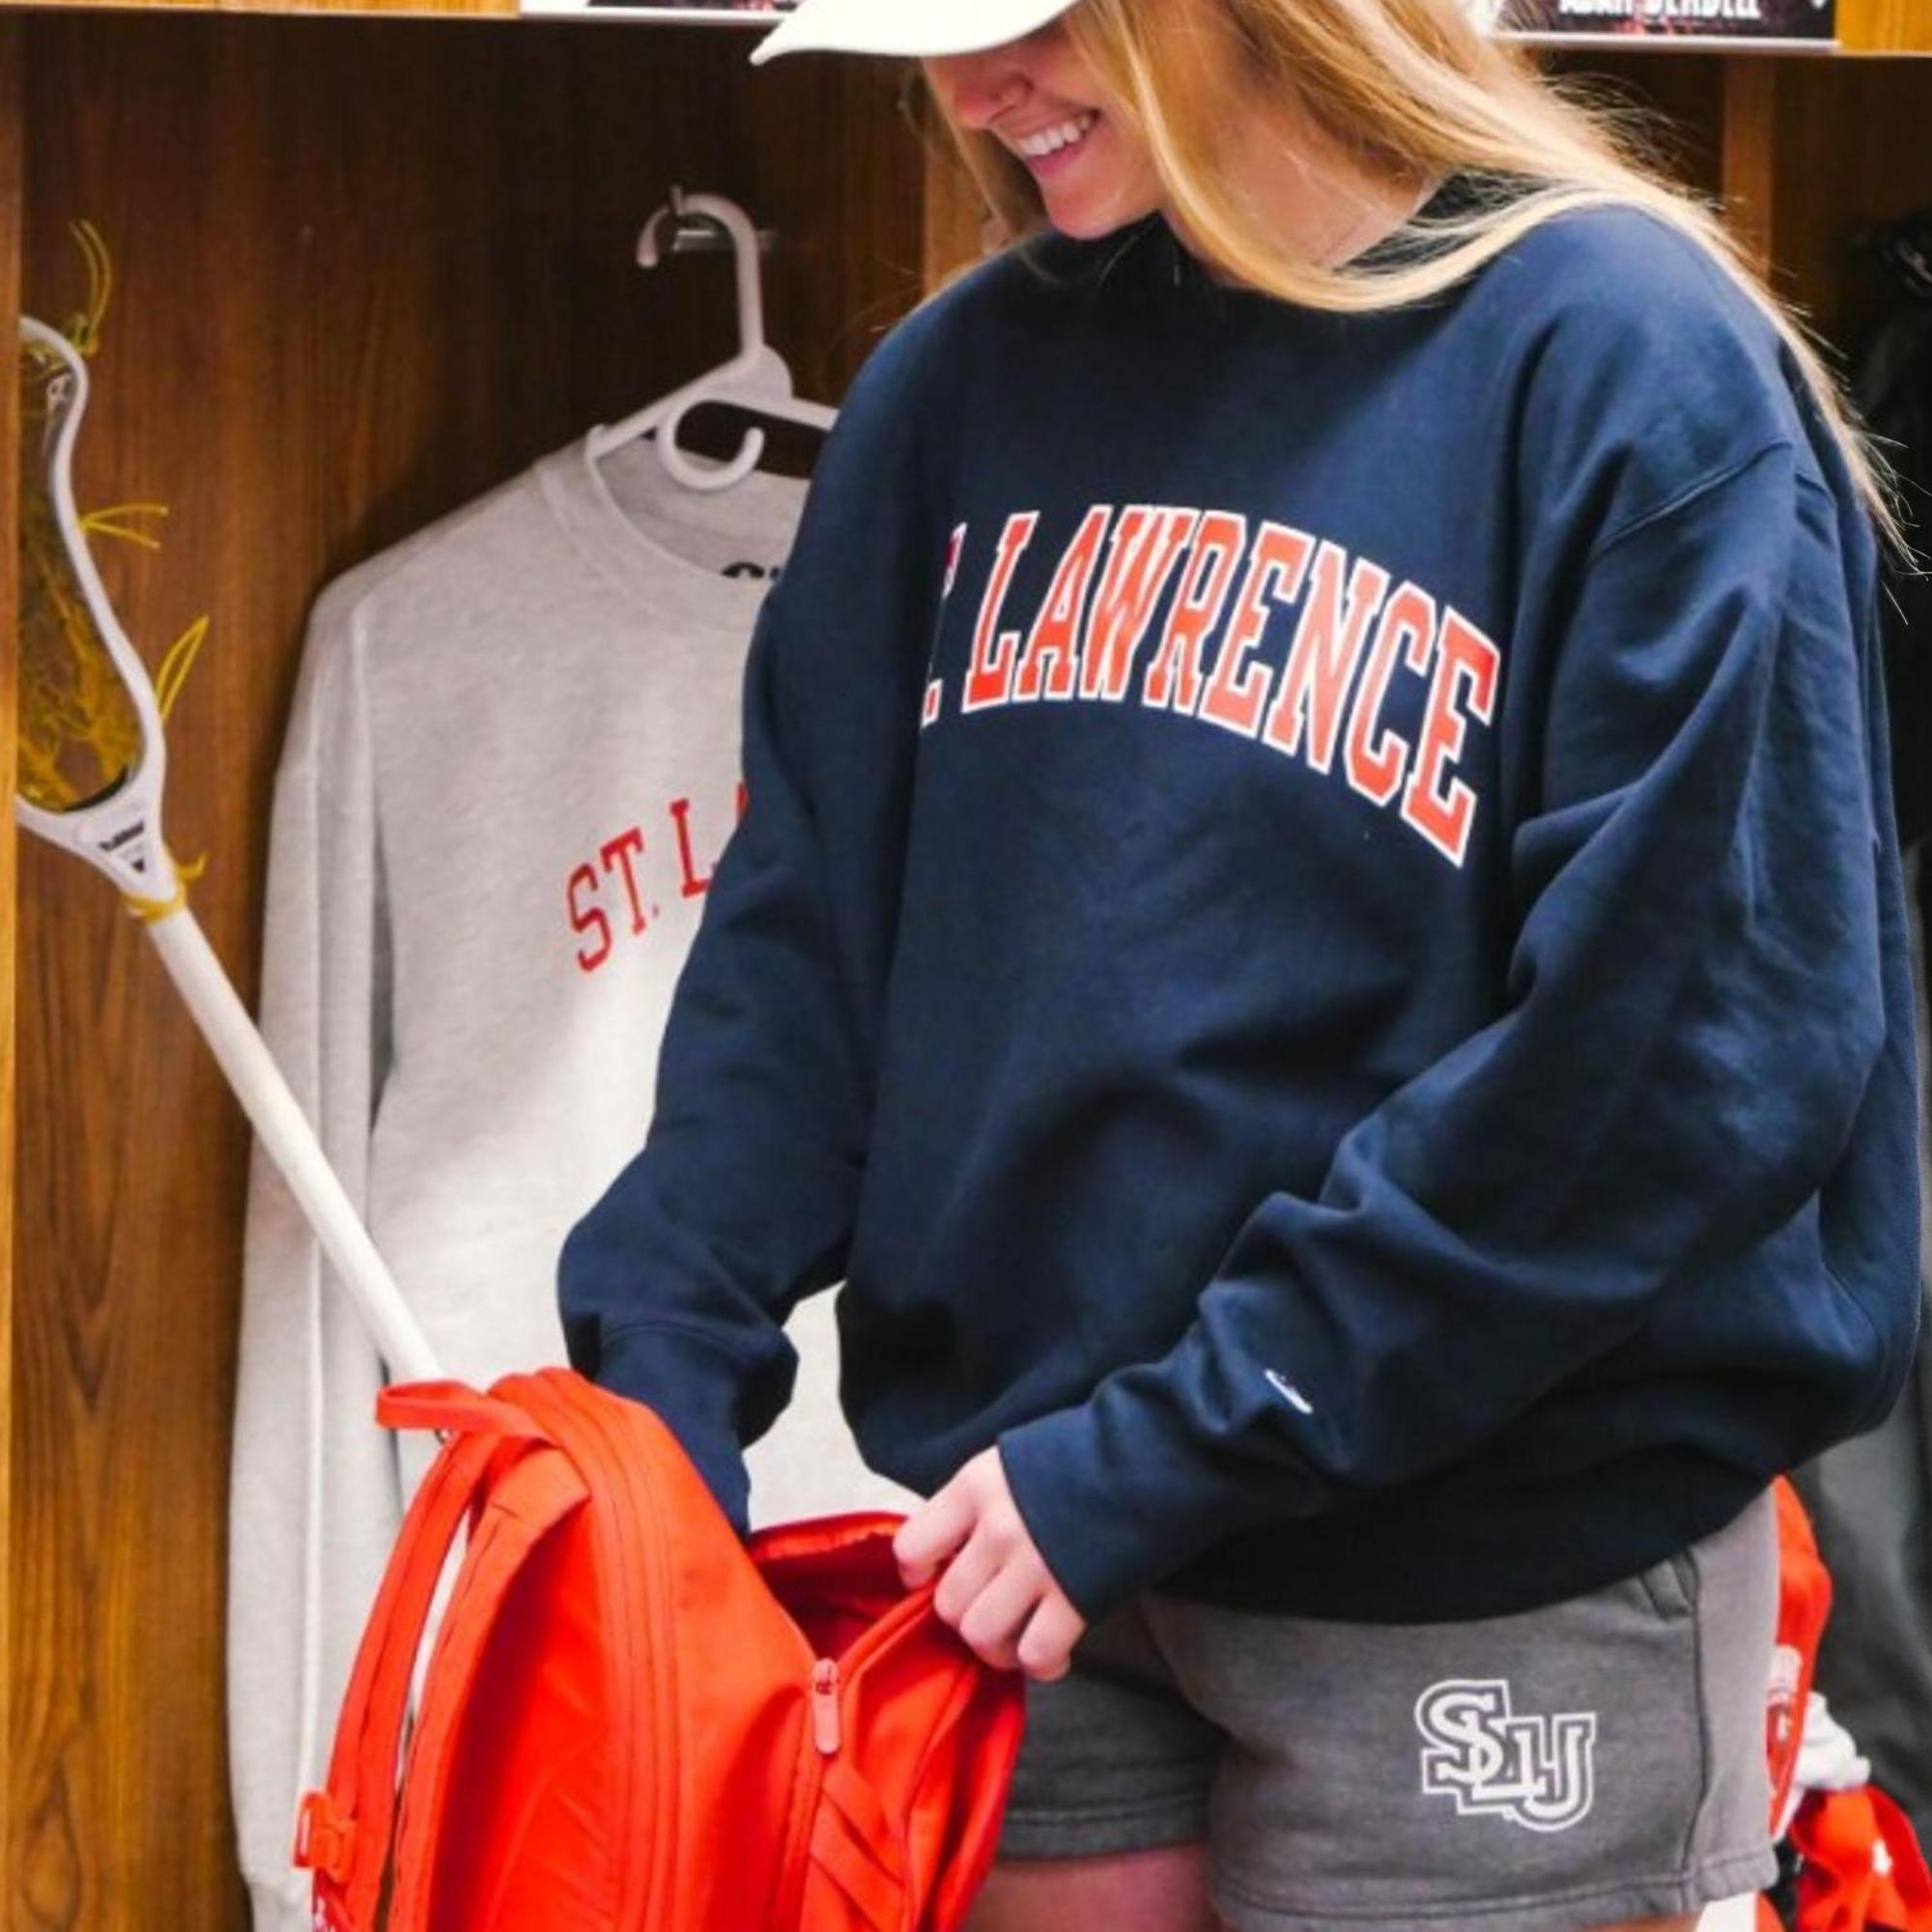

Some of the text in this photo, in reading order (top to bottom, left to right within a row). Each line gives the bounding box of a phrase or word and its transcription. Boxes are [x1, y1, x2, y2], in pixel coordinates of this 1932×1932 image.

[962, 503, 1501, 868] LAWRENCE
[566, 781, 749, 972] ST. L
[1414, 1679, 1597, 1833] SLU
